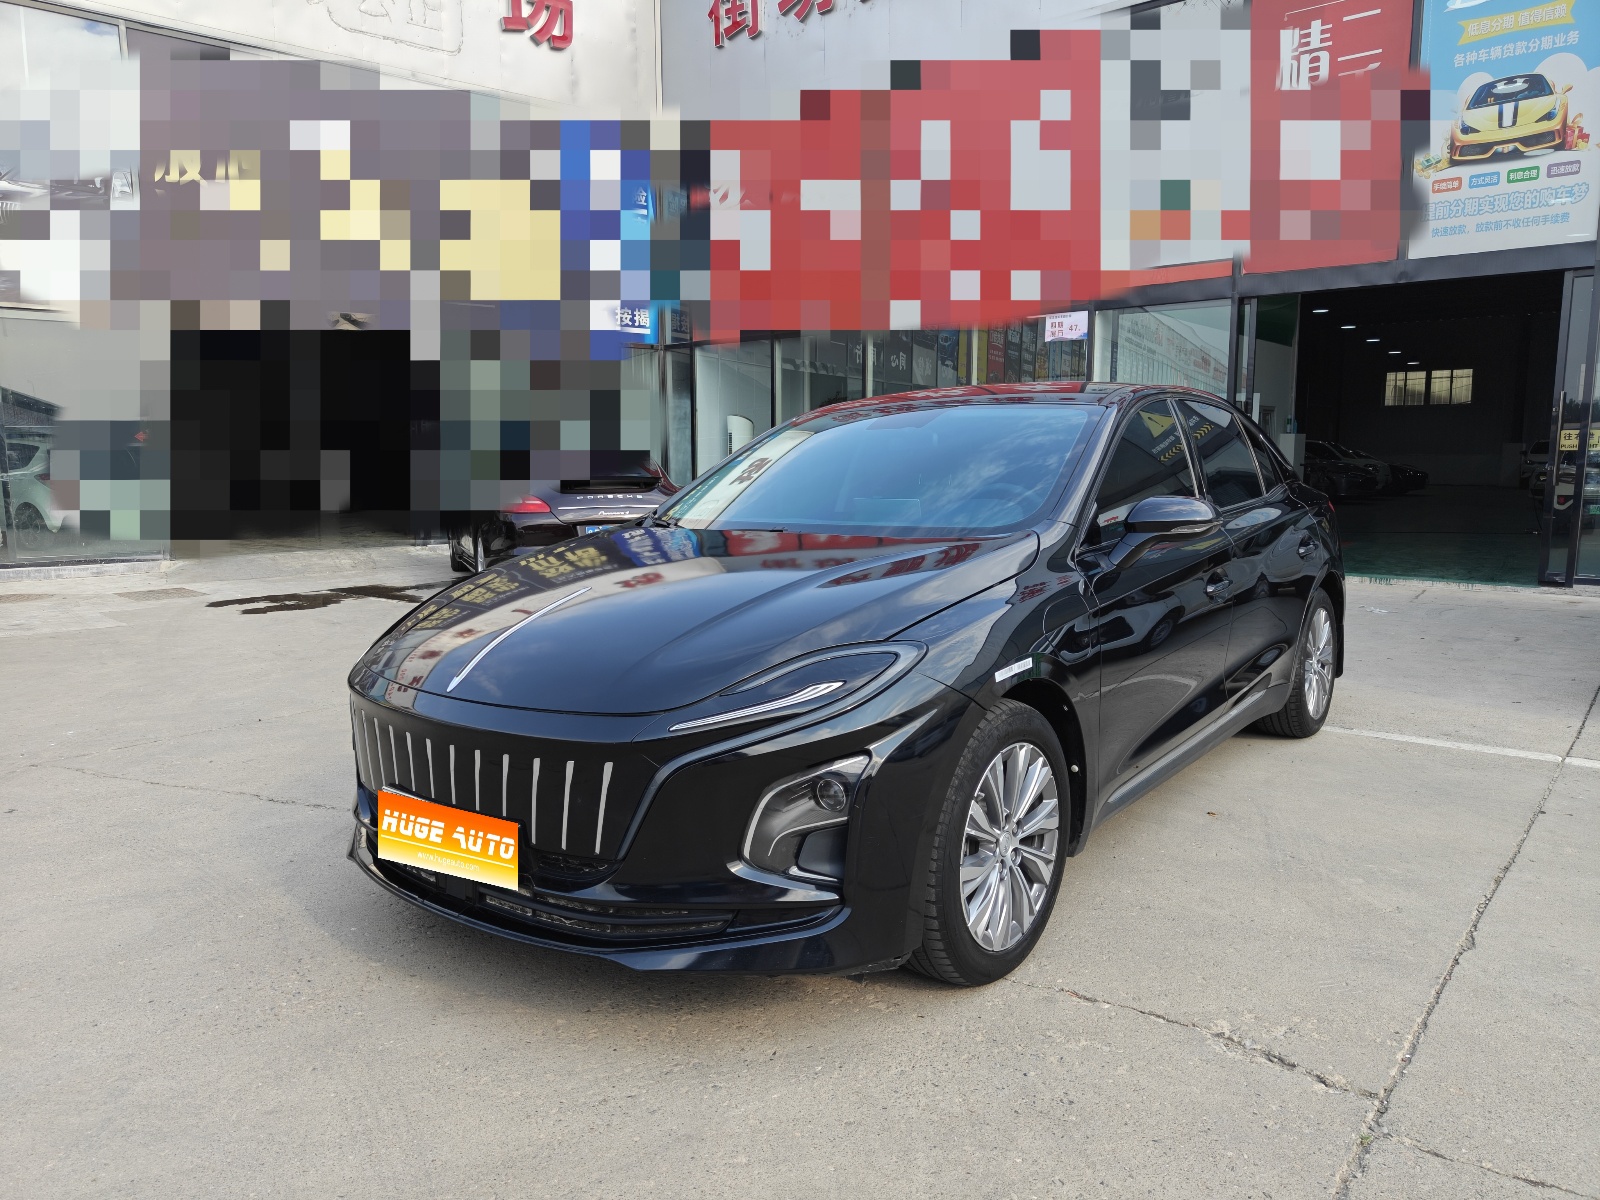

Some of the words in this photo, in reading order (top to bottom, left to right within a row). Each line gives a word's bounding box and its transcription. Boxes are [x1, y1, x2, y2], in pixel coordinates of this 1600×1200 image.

[1467, 15, 1514, 37] 低息分期
[1518, 4, 1567, 27] 值得信赖
[1453, 31, 1580, 68] 各种车辆贷款分期业务
[1470, 175, 1498, 186] 方式灵活
[1509, 169, 1538, 180] 利息合理
